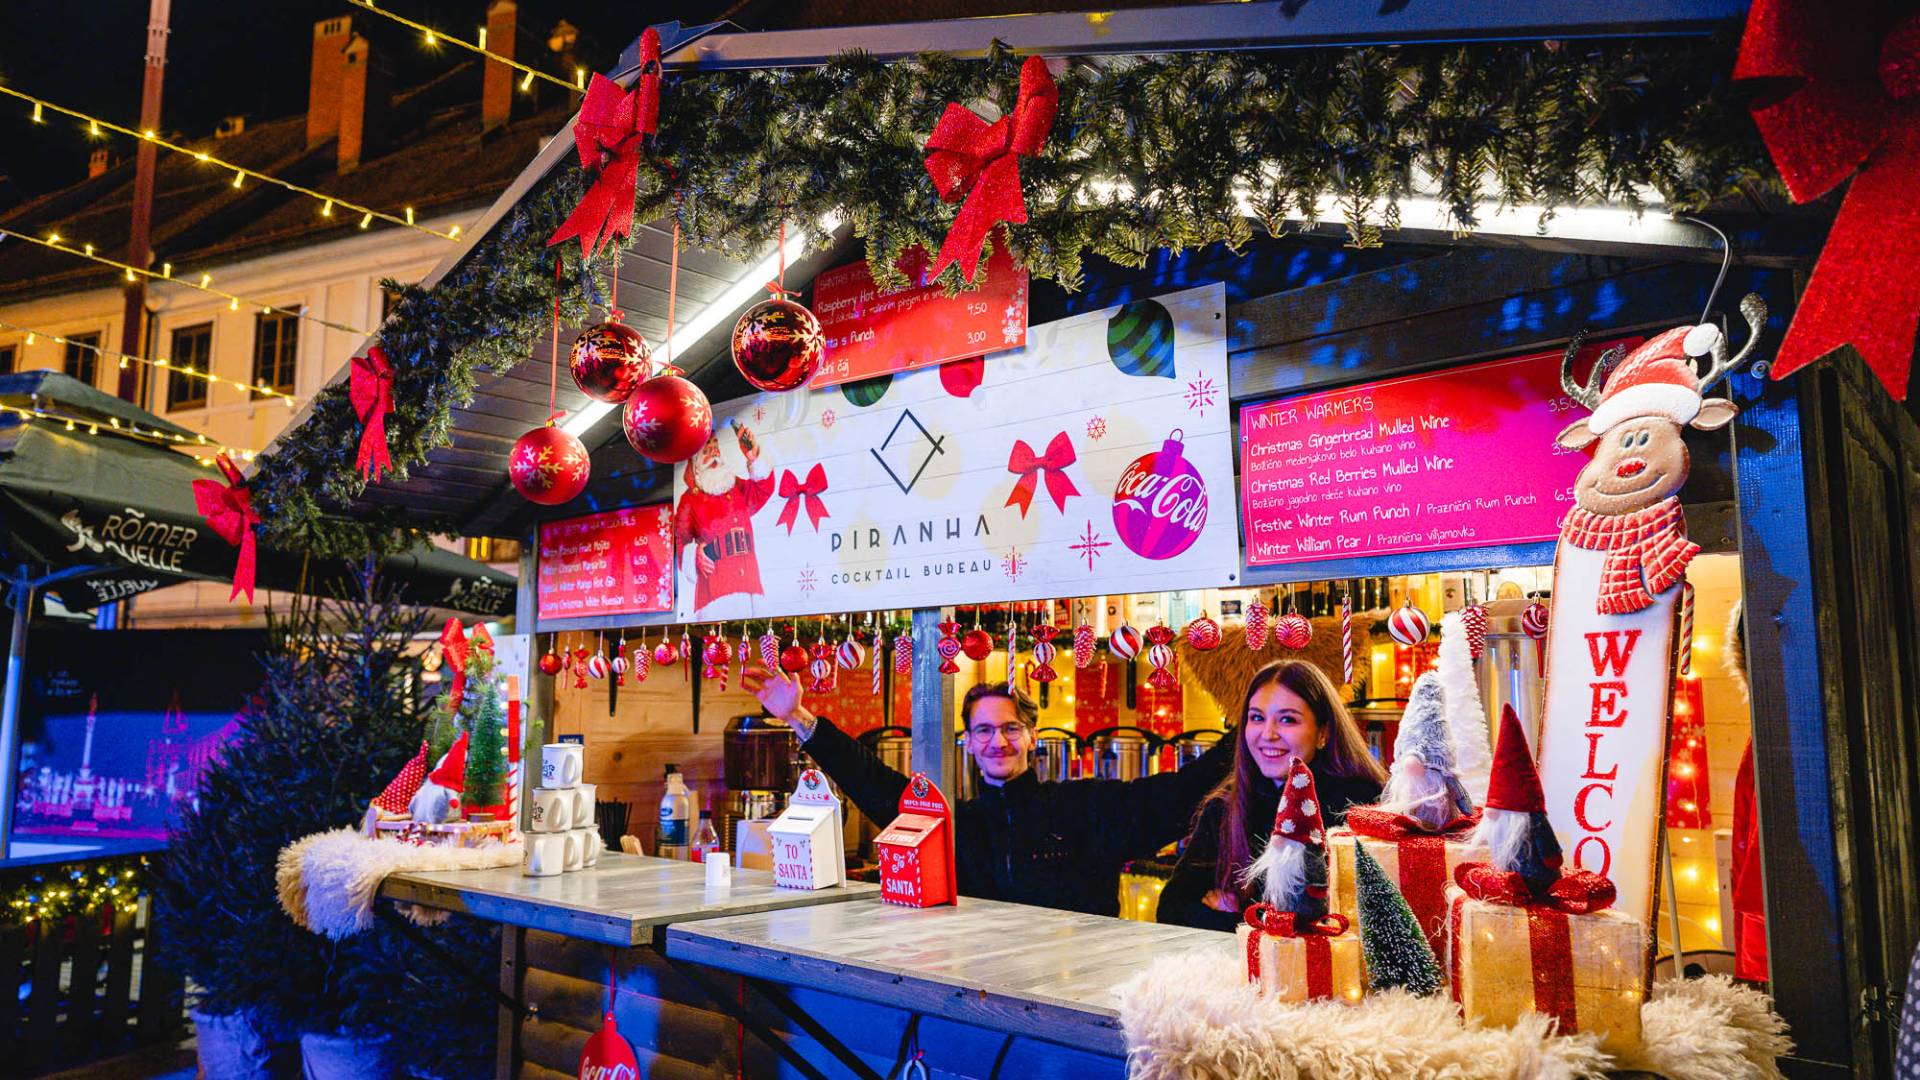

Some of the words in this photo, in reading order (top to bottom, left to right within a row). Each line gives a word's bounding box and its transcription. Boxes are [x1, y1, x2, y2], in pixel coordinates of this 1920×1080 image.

[817, 296, 857, 315] Raspberry
[860, 288, 875, 303] Hot
[850, 327, 875, 344] Punch
[1250, 408, 1298, 430] WINTER
[1305, 396, 1374, 421] WARMERS
[1251, 439, 1303, 457] Christmas
[1308, 421, 1374, 451] Gingerbread
[1379, 417, 1415, 437] Mulled
[1420, 414, 1450, 430] Wine
[1340, 448, 1357, 460] belo
[1361, 443, 1392, 456] kuhano
[1397, 439, 1416, 451] vino
[1251, 477, 1304, 494] Christmas
[1309, 469, 1331, 486] Red
[1336, 466, 1377, 483] Berries
[1382, 457, 1419, 477] Mulled
[1424, 455, 1454, 471] Wine
[1286, 491, 1318, 510] jagodno
[1348, 485, 1379, 498] kuhano
[1384, 482, 1402, 494] vino
[1254, 518, 1293, 534] Festive
[1297, 514, 1334, 528] Winter
[1340, 509, 1368, 524] Rum
[1373, 503, 1410, 520] Punch
[1415, 503, 1421, 516] /
[1475, 497, 1500, 510] Rum
[1505, 492, 1537, 507] Punch
[831, 513, 991, 552] PIRANHA
[1256, 542, 1291, 556] Winter
[1296, 535, 1332, 553] William
[1336, 534, 1361, 548] Pear
[1366, 534, 1371, 547] /
[831, 567, 911, 585] COCKTAIL
[923, 559, 992, 577] BUREAU
[1573, 629, 1643, 878] WELCO
[785, 844, 799, 860] TO
[778, 863, 808, 881] SANTA
[886, 878, 915, 897] SANTA
